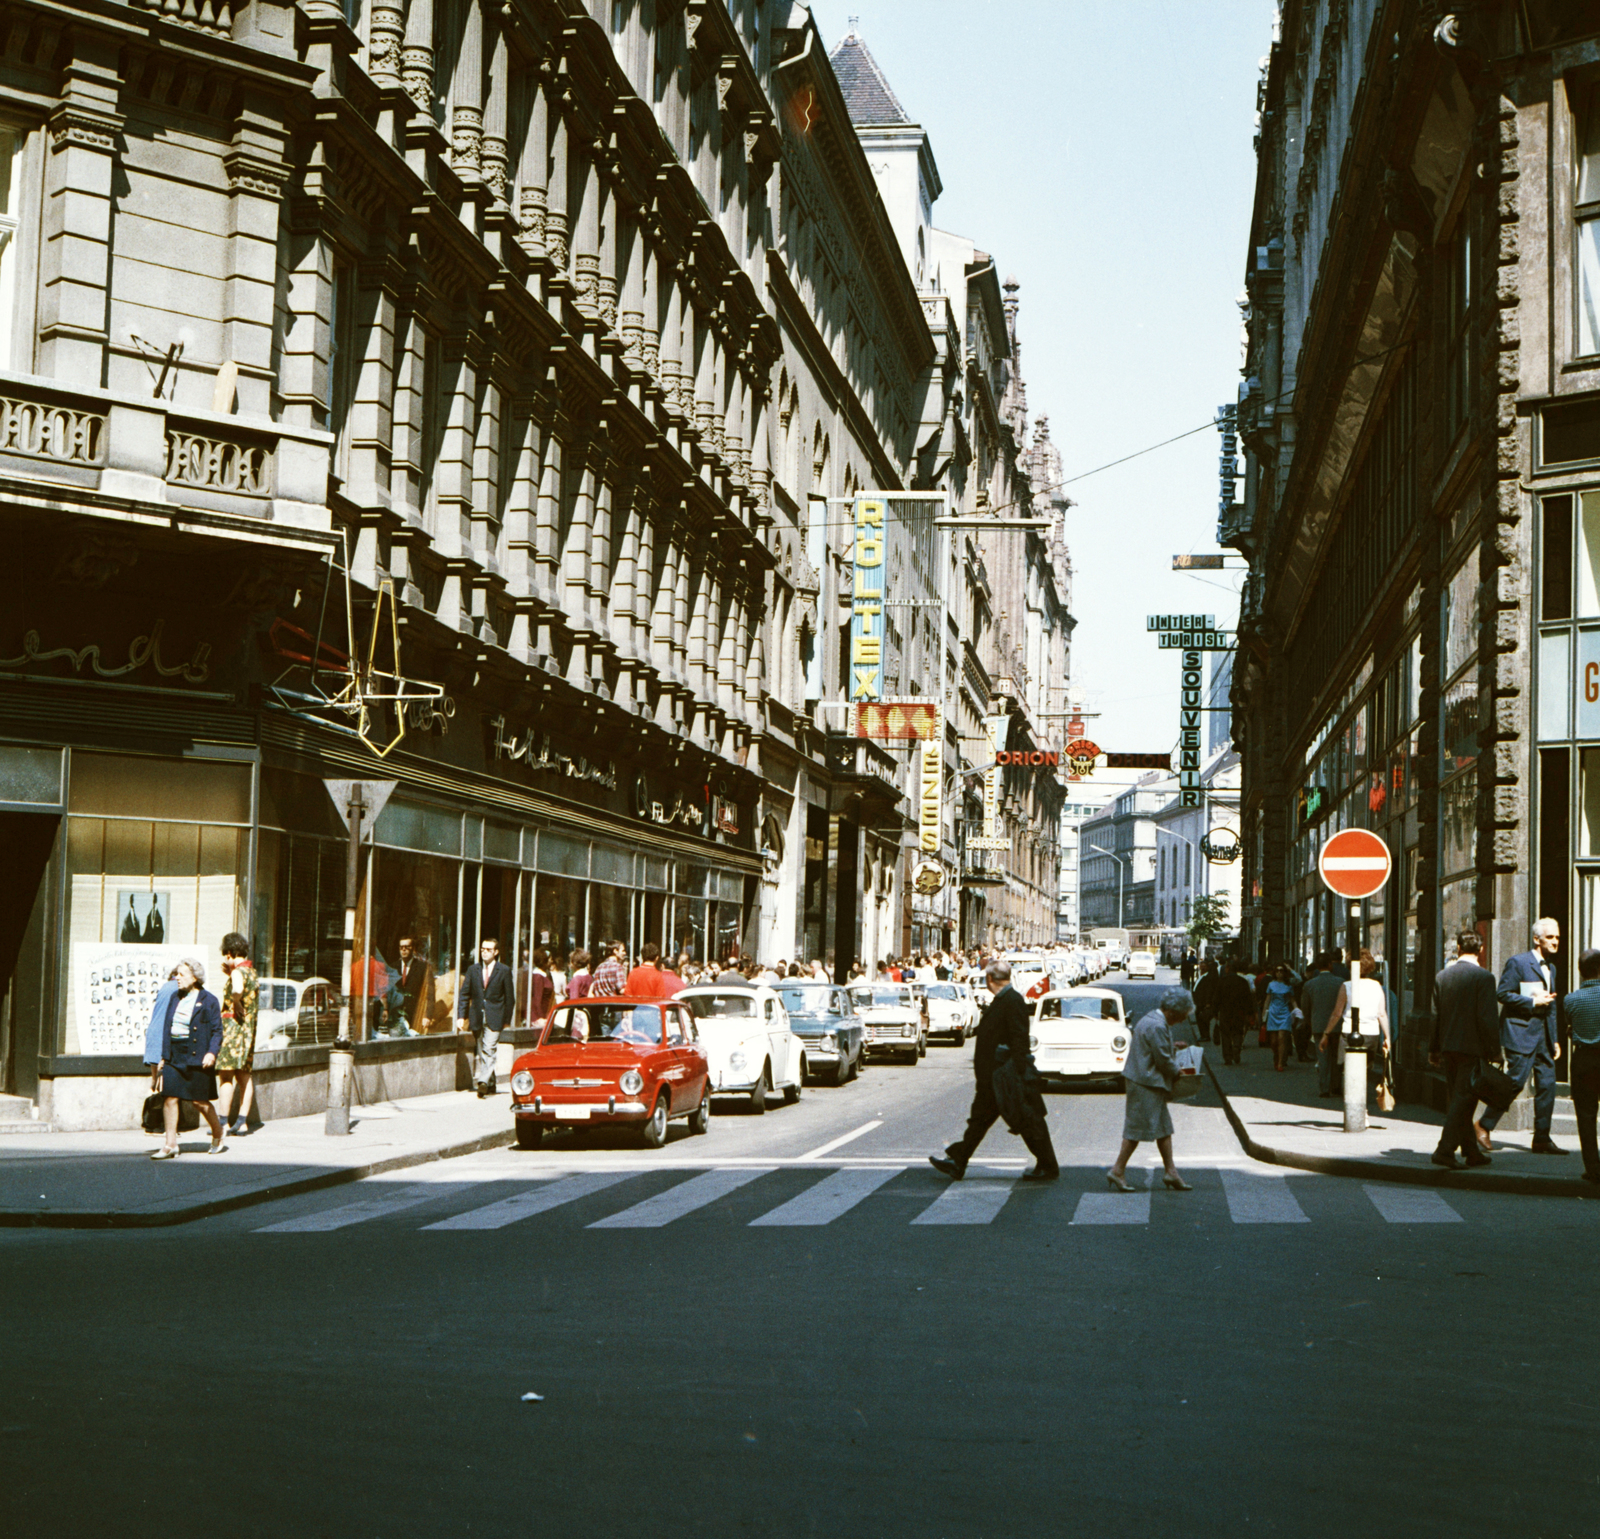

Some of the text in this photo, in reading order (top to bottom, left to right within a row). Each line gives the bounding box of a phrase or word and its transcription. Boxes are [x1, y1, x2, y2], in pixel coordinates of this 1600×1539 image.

[853, 500, 884, 697] RÖLTEX
[1149, 616, 1213, 630] INTER-
[1160, 633, 1227, 648] TURIST
[1585, 661, 1600, 703] G
[1182, 651, 1201, 806] SOUVENIR
[1066, 740, 1101, 755] ORION
[997, 751, 1059, 766] ORION
[1109, 753, 1168, 767] ORION
